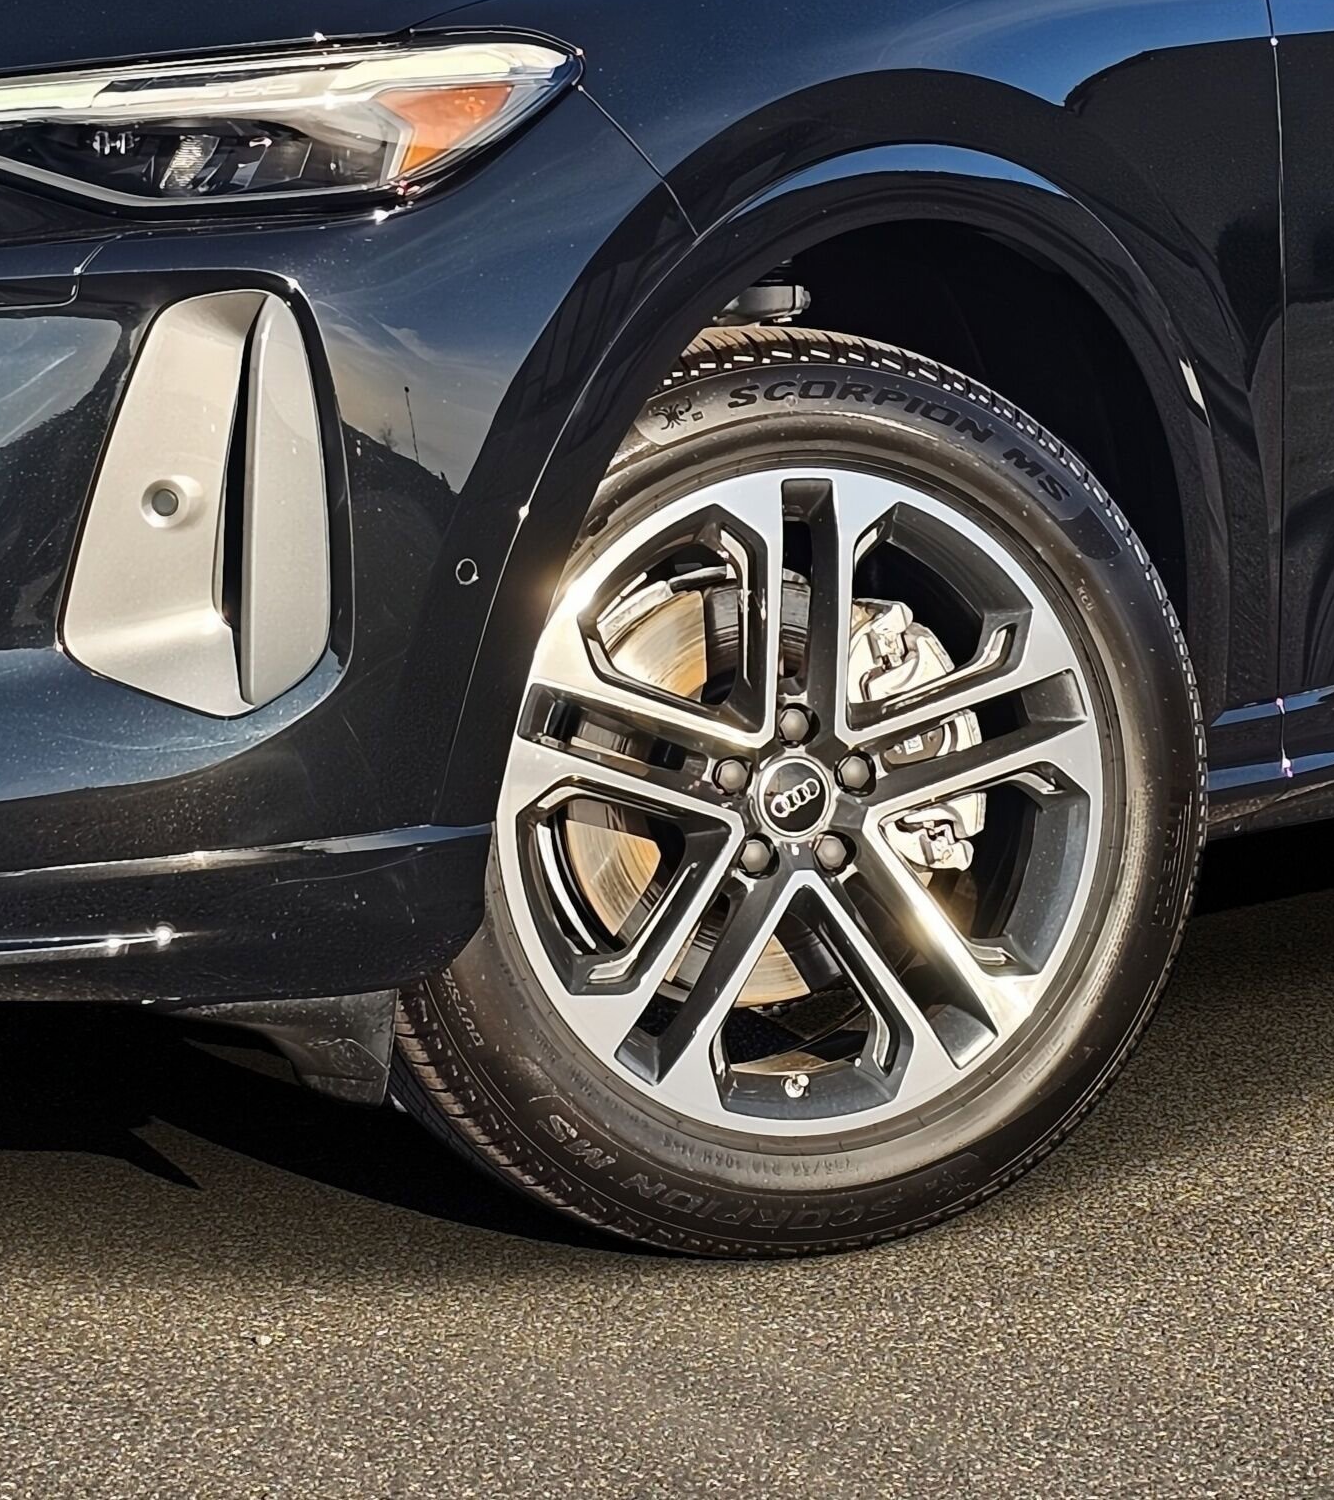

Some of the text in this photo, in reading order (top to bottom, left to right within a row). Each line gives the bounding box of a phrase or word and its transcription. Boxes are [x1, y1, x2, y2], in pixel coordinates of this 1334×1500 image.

[726, 380, 1073, 503] SCORPION MS
[619, 1172, 903, 1230] SCORPION
